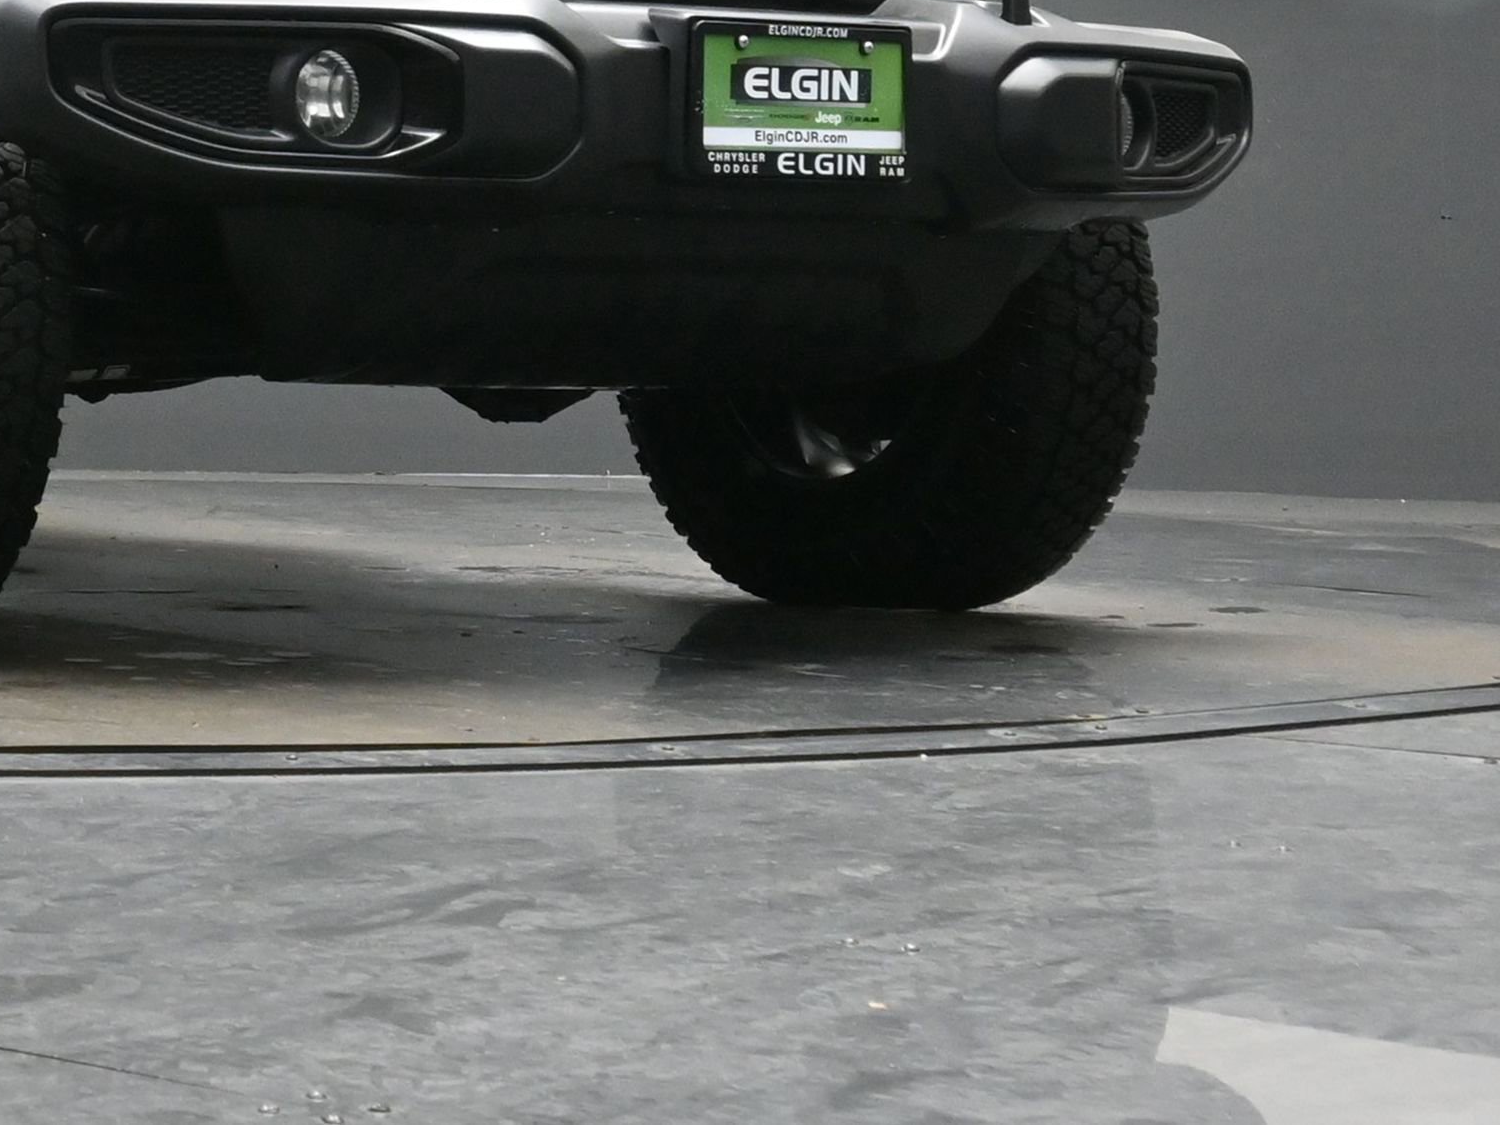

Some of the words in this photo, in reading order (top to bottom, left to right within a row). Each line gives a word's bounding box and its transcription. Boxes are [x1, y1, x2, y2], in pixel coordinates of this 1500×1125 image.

[768, 24, 848, 38] ELGINCDJR.COM
[743, 66, 860, 102] ELGIN
[814, 111, 842, 126] Jeep
[754, 130, 848, 146] ElginCDJR.com
[708, 151, 766, 163] CHRYSLER
[879, 155, 906, 166] JEEP
[713, 164, 759, 175] DODGE
[777, 153, 866, 177] ELGIN
[879, 167, 905, 177] RAM
